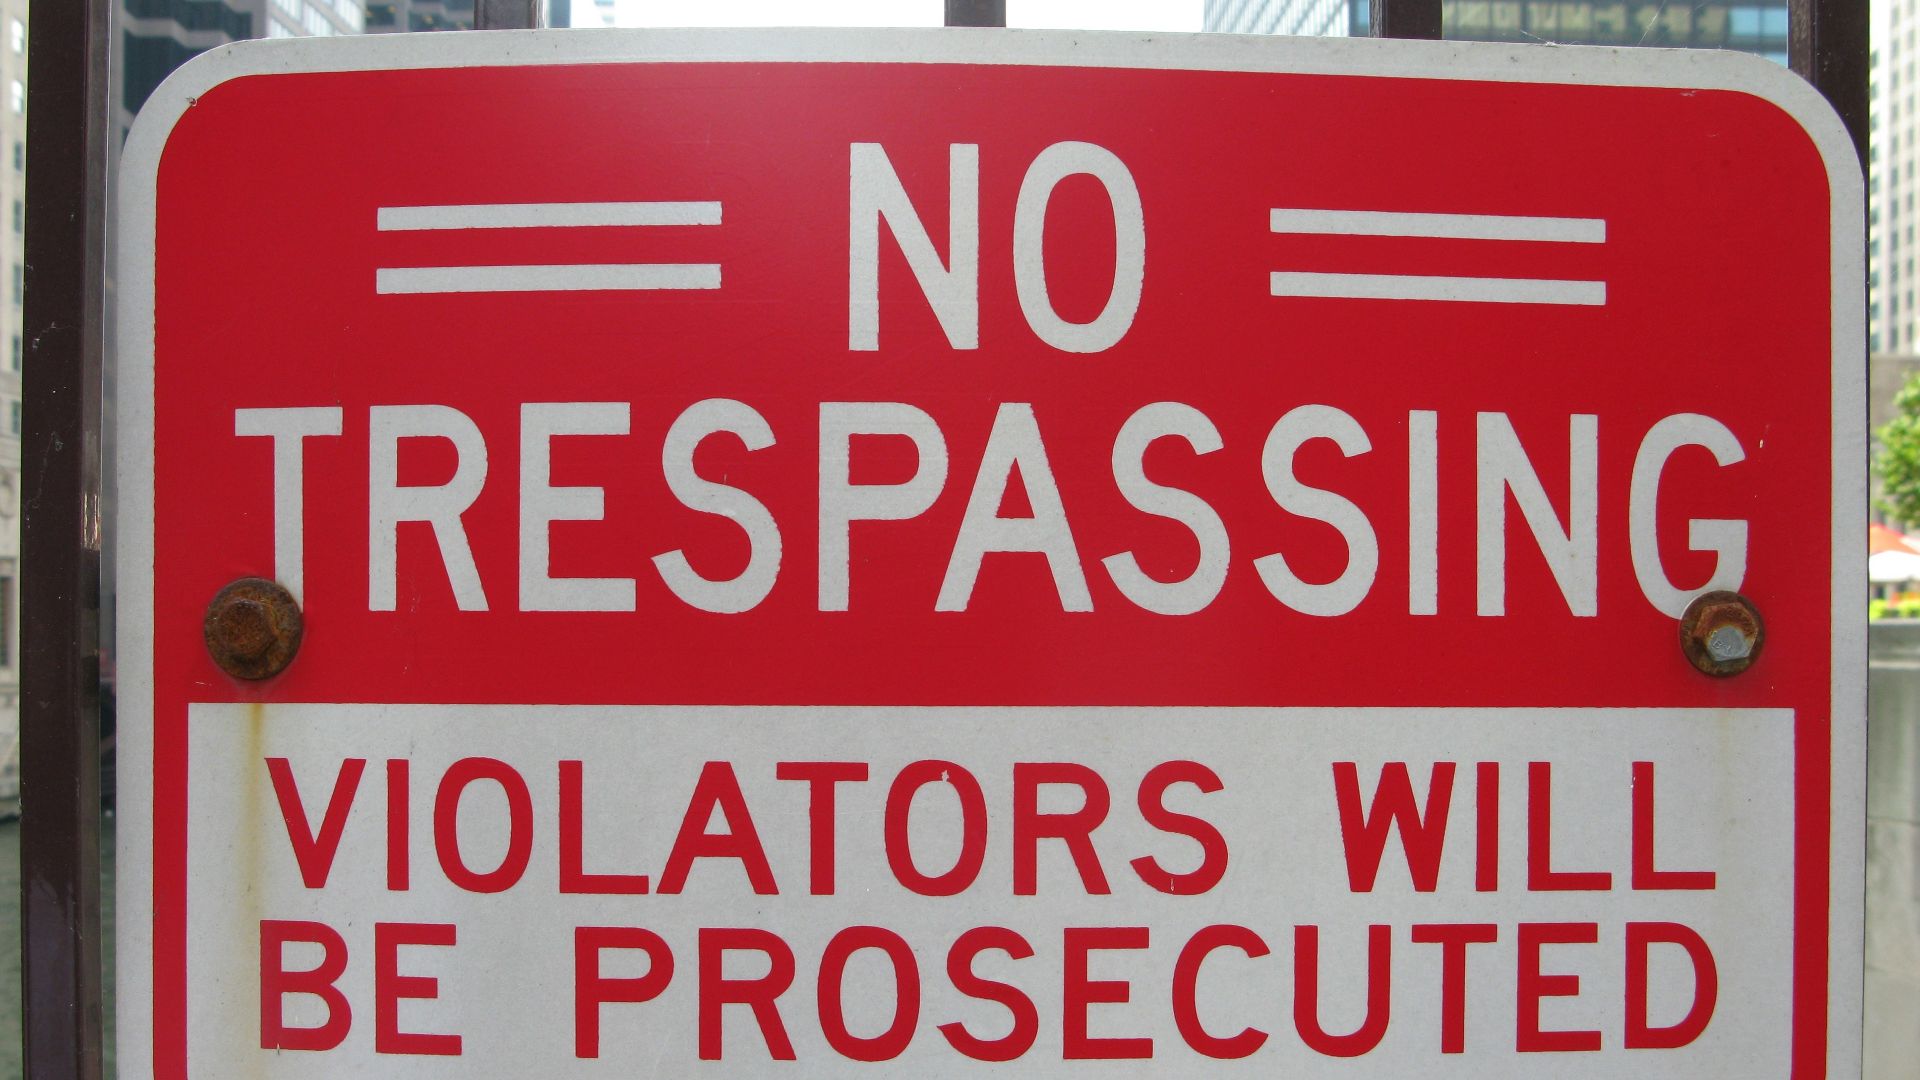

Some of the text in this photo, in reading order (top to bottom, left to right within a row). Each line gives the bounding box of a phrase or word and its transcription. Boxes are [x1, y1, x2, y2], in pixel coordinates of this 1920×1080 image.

[849, 141, 1145, 353] NO
[234, 398, 1749, 620] TRESPASSING
[266, 758, 1715, 896] VIOLATORS WILL
[260, 920, 1718, 1062] BE PROSECUTED
